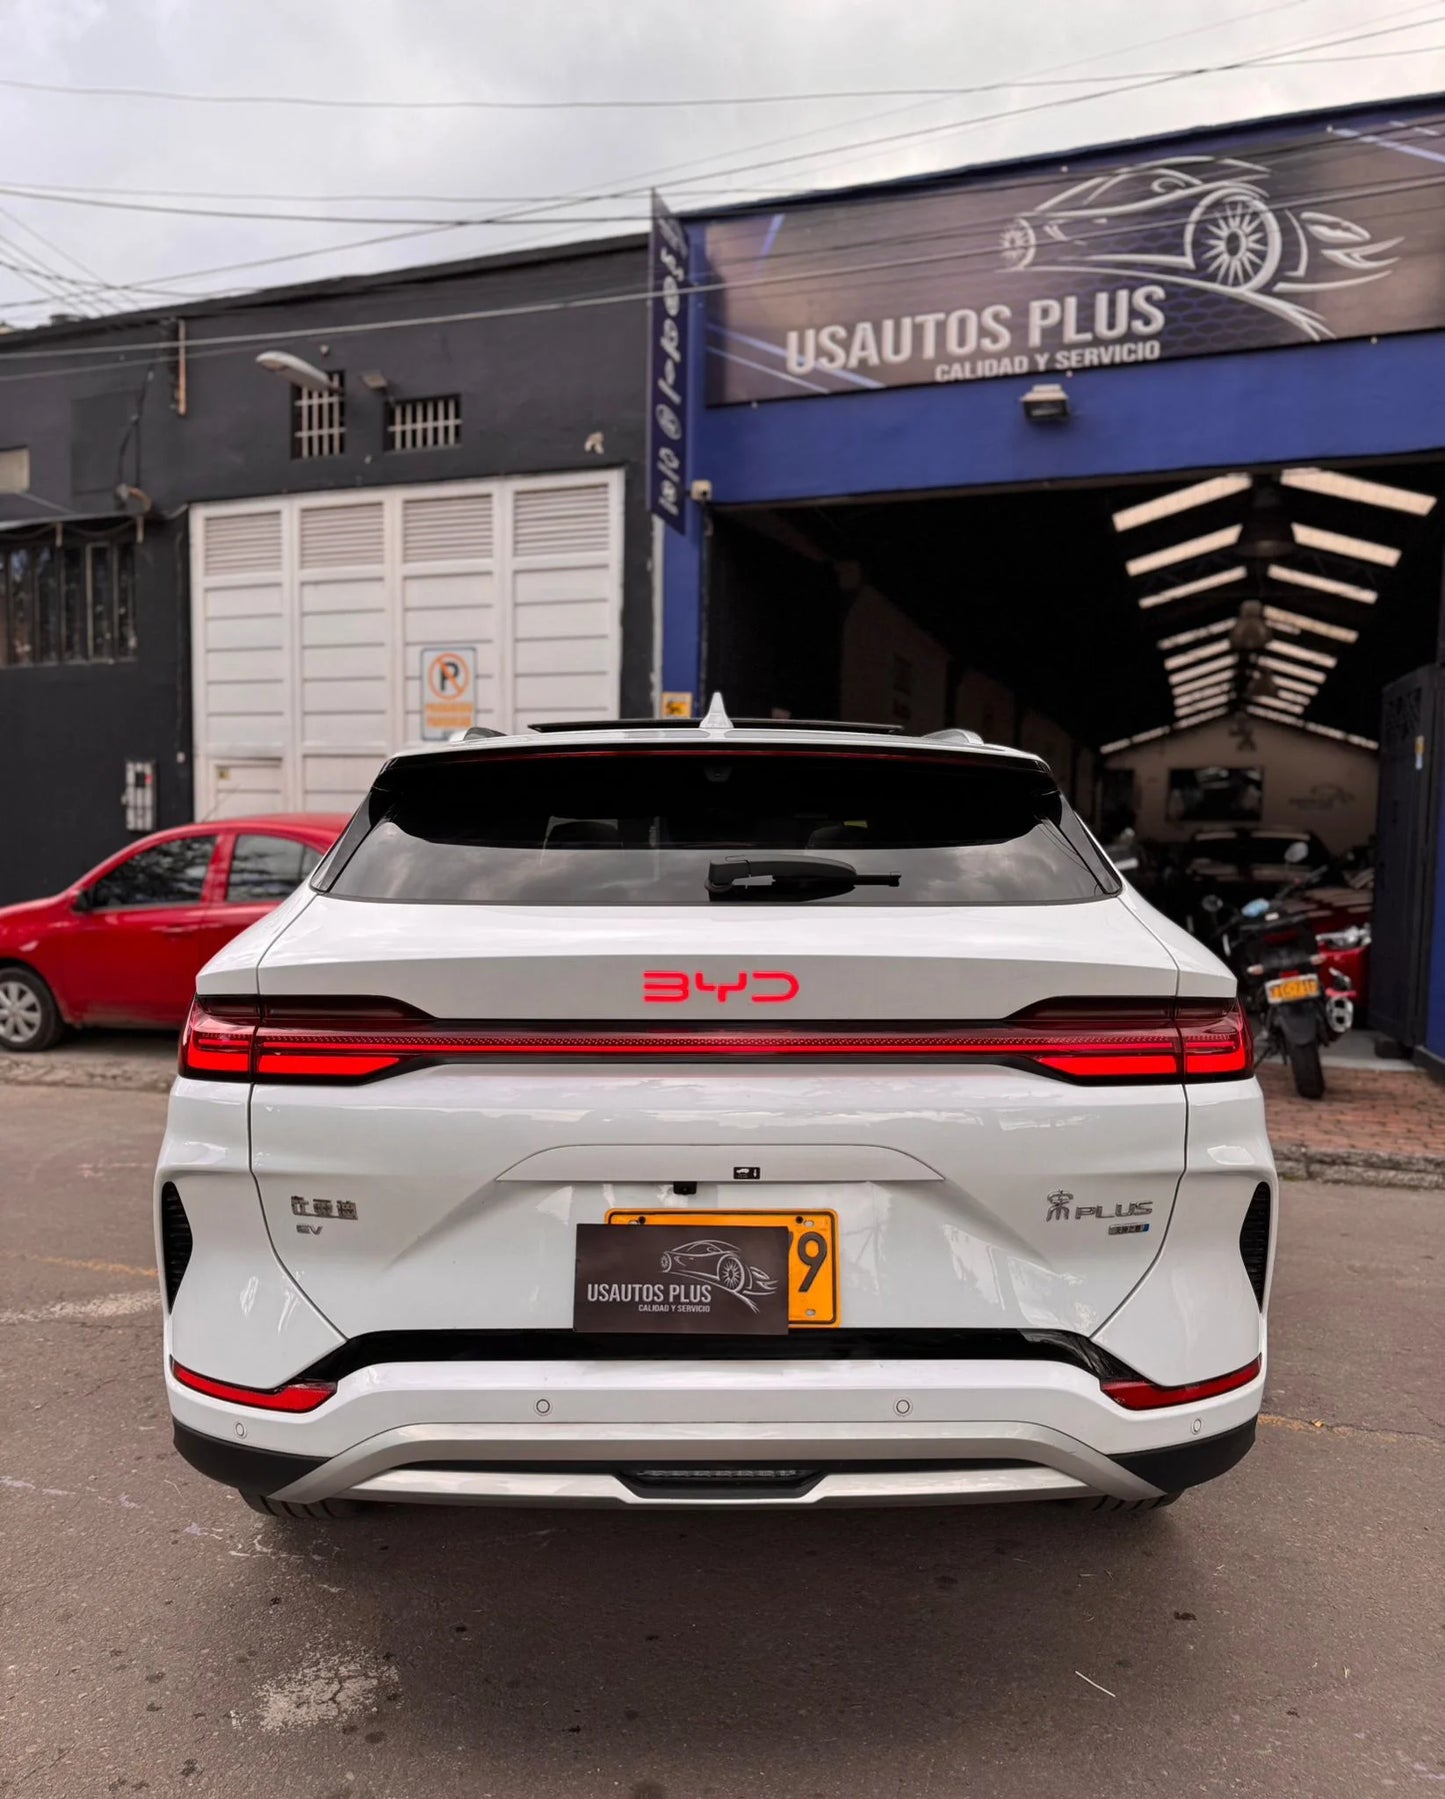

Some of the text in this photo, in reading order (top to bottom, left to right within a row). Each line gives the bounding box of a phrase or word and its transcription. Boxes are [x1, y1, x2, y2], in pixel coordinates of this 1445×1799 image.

[785, 285, 1166, 375] USAUTOS PLUS
[934, 339, 1161, 383] CALIDAD Y SERVICIO
[643, 971, 800, 1003] BYD
[1074, 1201, 1154, 1220] PLUS
[296, 1224, 323, 1235] EV
[787, 1231, 828, 1293] 9
[587, 1283, 712, 1303] USAUTOS PLUS
[638, 1304, 711, 1313] CALIDAD Y SERVICIO
